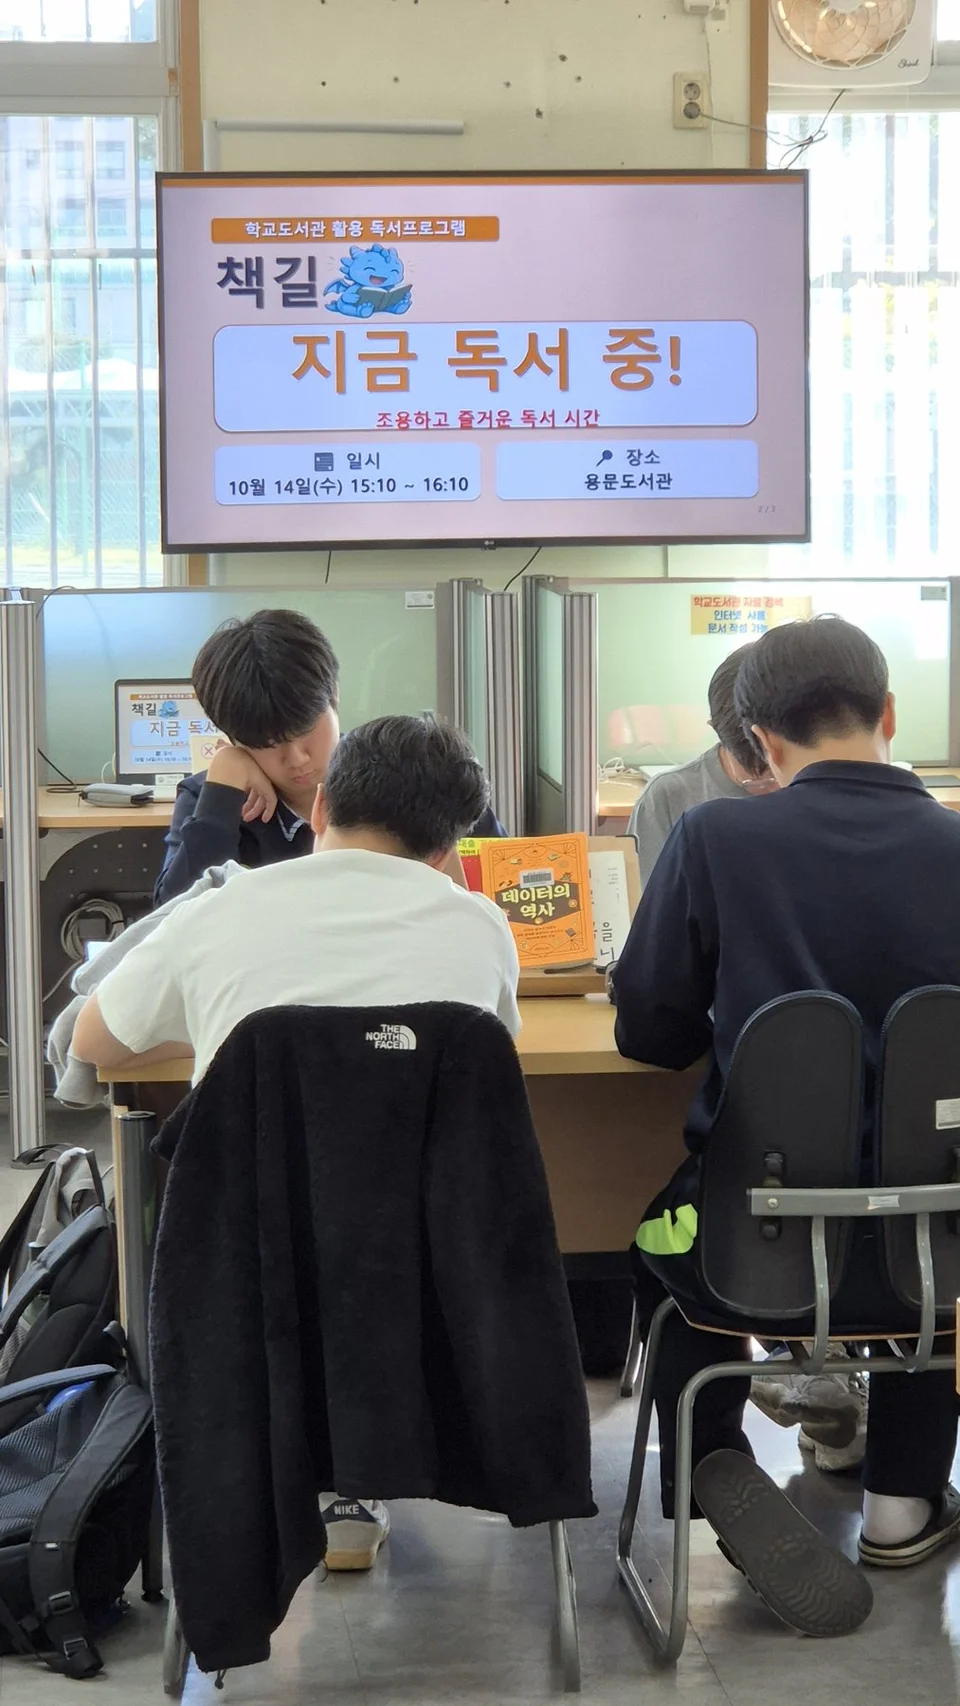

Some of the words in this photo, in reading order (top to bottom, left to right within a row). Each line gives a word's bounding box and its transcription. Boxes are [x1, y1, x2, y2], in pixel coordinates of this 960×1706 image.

[245, 221, 326, 239] 학교도서관
[331, 220, 364, 238] 활용
[370, 219, 467, 237] 독서프로그램
[216, 255, 319, 310] 책길
[291, 330, 418, 395] 지금
[447, 328, 570, 392] 독서
[602, 328, 682, 392] 중!
[375, 410, 450, 430] 조용하고
[457, 410, 513, 430] 즐거운
[520, 409, 559, 429] 독서
[564, 408, 600, 428] 시간
[346, 451, 381, 470] 일시
[626, 448, 661, 467] 장소
[229, 478, 266, 497] 10월
[274, 477, 344, 497] 14일(수)
[351, 477, 397, 493] 15:10
[423, 476, 469, 493] 16:10
[584, 472, 673, 491] 용문도서관
[694, 596, 741, 608] 학교도서관
[713, 610, 742, 621] 인터넷
[708, 623, 727, 634] 문서
[132, 703, 157, 716] 책길
[150, 720, 181, 737] 지금
[501, 883, 570, 903] 데이터의
[520, 902, 555, 919] 역사
[365, 1031, 400, 1041] NORTH
[380, 1023, 400, 1033] THE
[374, 1040, 400, 1049] FACE
[333, 1504, 360, 1516] NIKE
